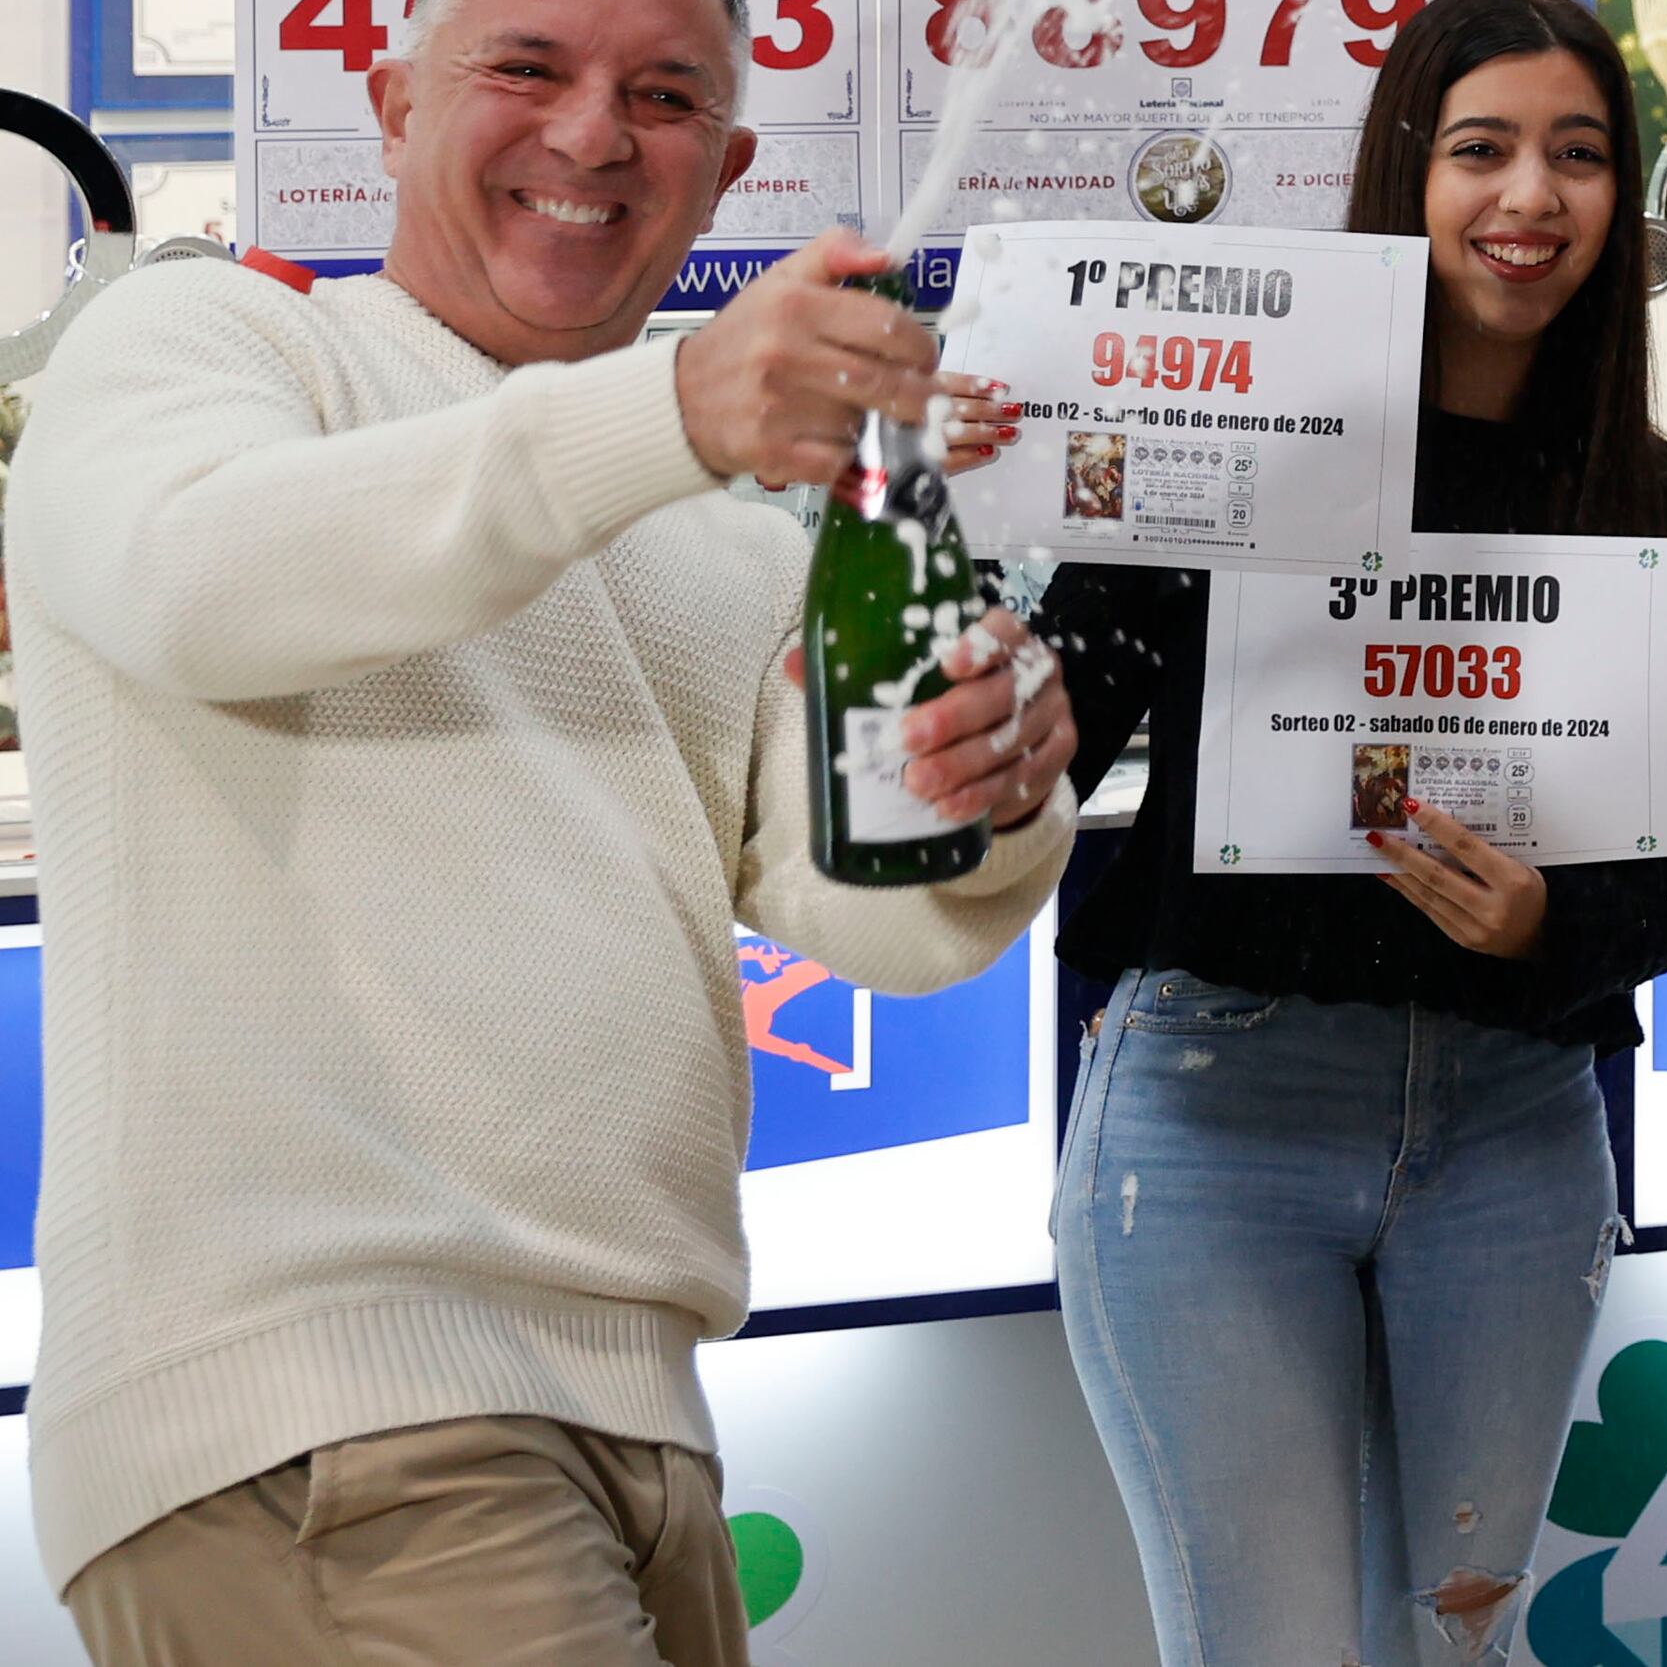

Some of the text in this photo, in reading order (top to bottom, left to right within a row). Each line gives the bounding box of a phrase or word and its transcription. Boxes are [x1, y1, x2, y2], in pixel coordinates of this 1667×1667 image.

[279, 184, 393, 205] LOTERÍA de
[1026, 175, 1116, 191] NAVIDAD
[1276, 174, 1297, 187] 22
[1067, 259, 1293, 319] 1º PREMIO
[1091, 331, 1254, 394] 94974
[1328, 574, 1560, 624] 3º PREMIO
[1363, 644, 1522, 700] 57033
